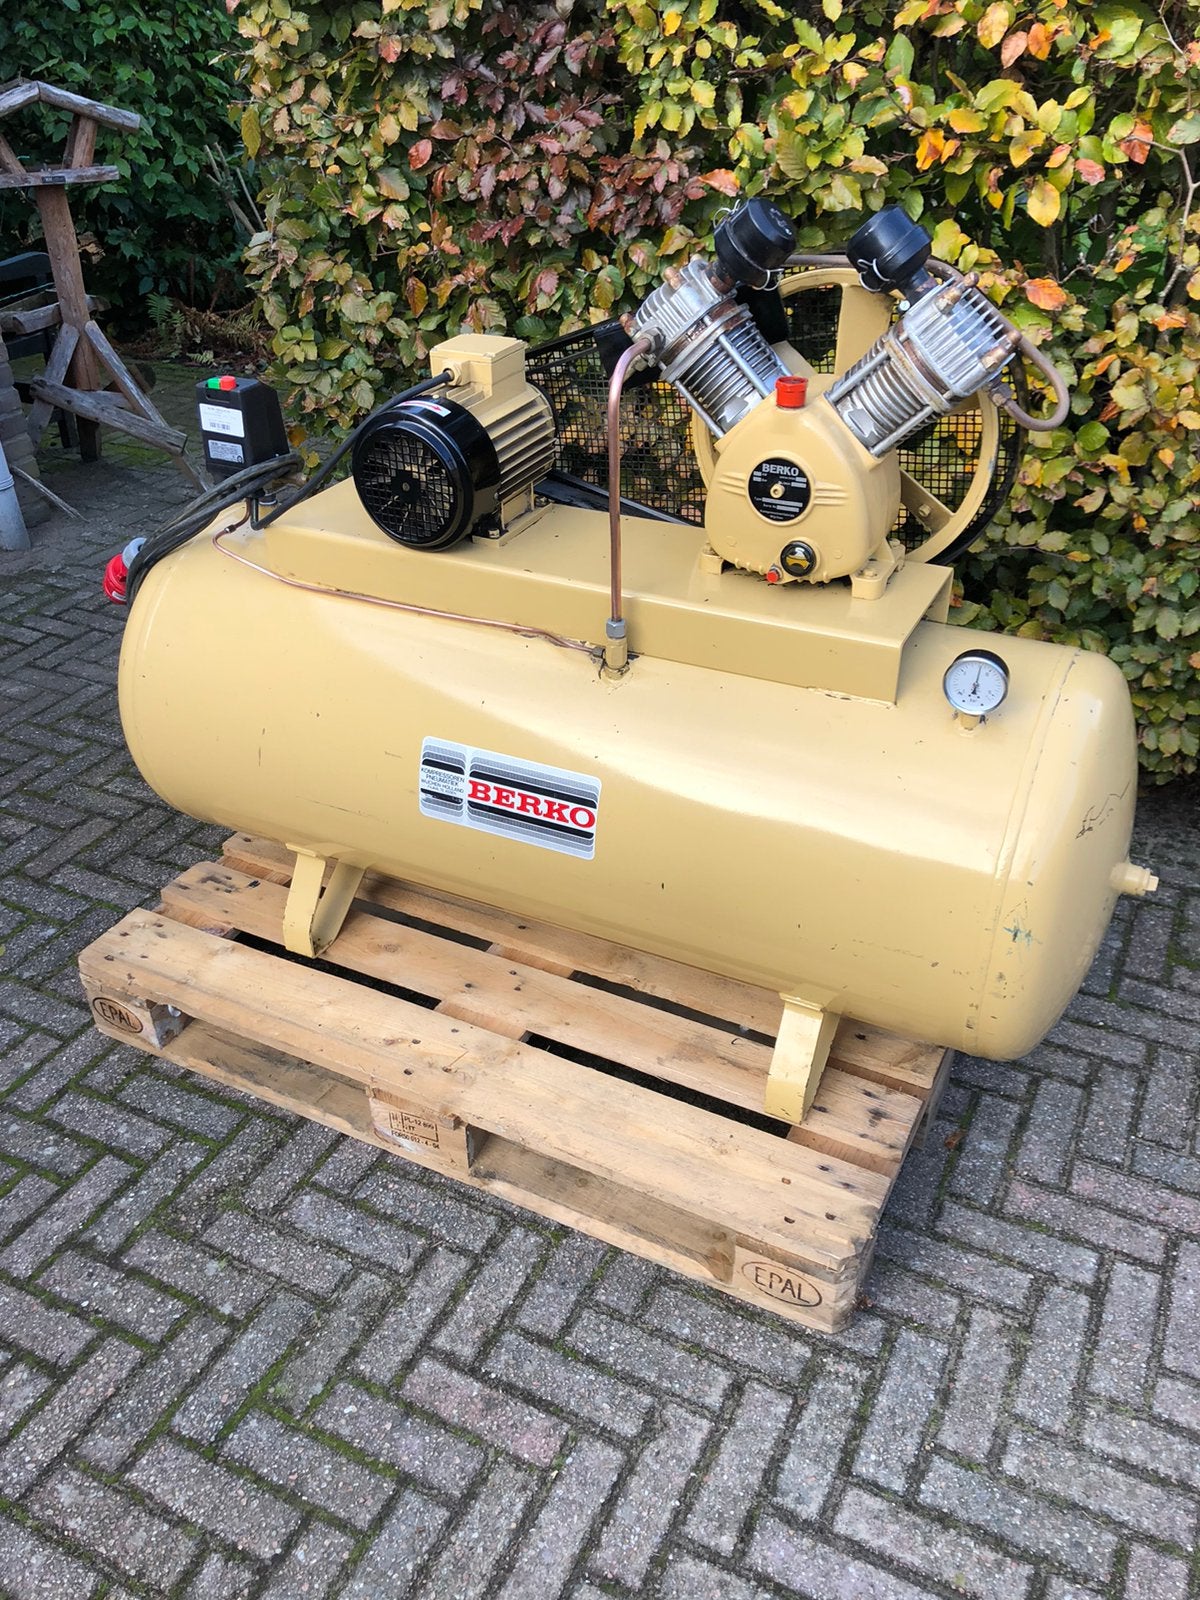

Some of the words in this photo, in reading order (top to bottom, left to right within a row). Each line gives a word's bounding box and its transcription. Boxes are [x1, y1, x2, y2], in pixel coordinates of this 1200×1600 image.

[762, 463, 799, 476] BERKO
[467, 779, 596, 828] BERKO
[100, 1001, 138, 1030] EPAL
[754, 1266, 810, 1304] EPAL
